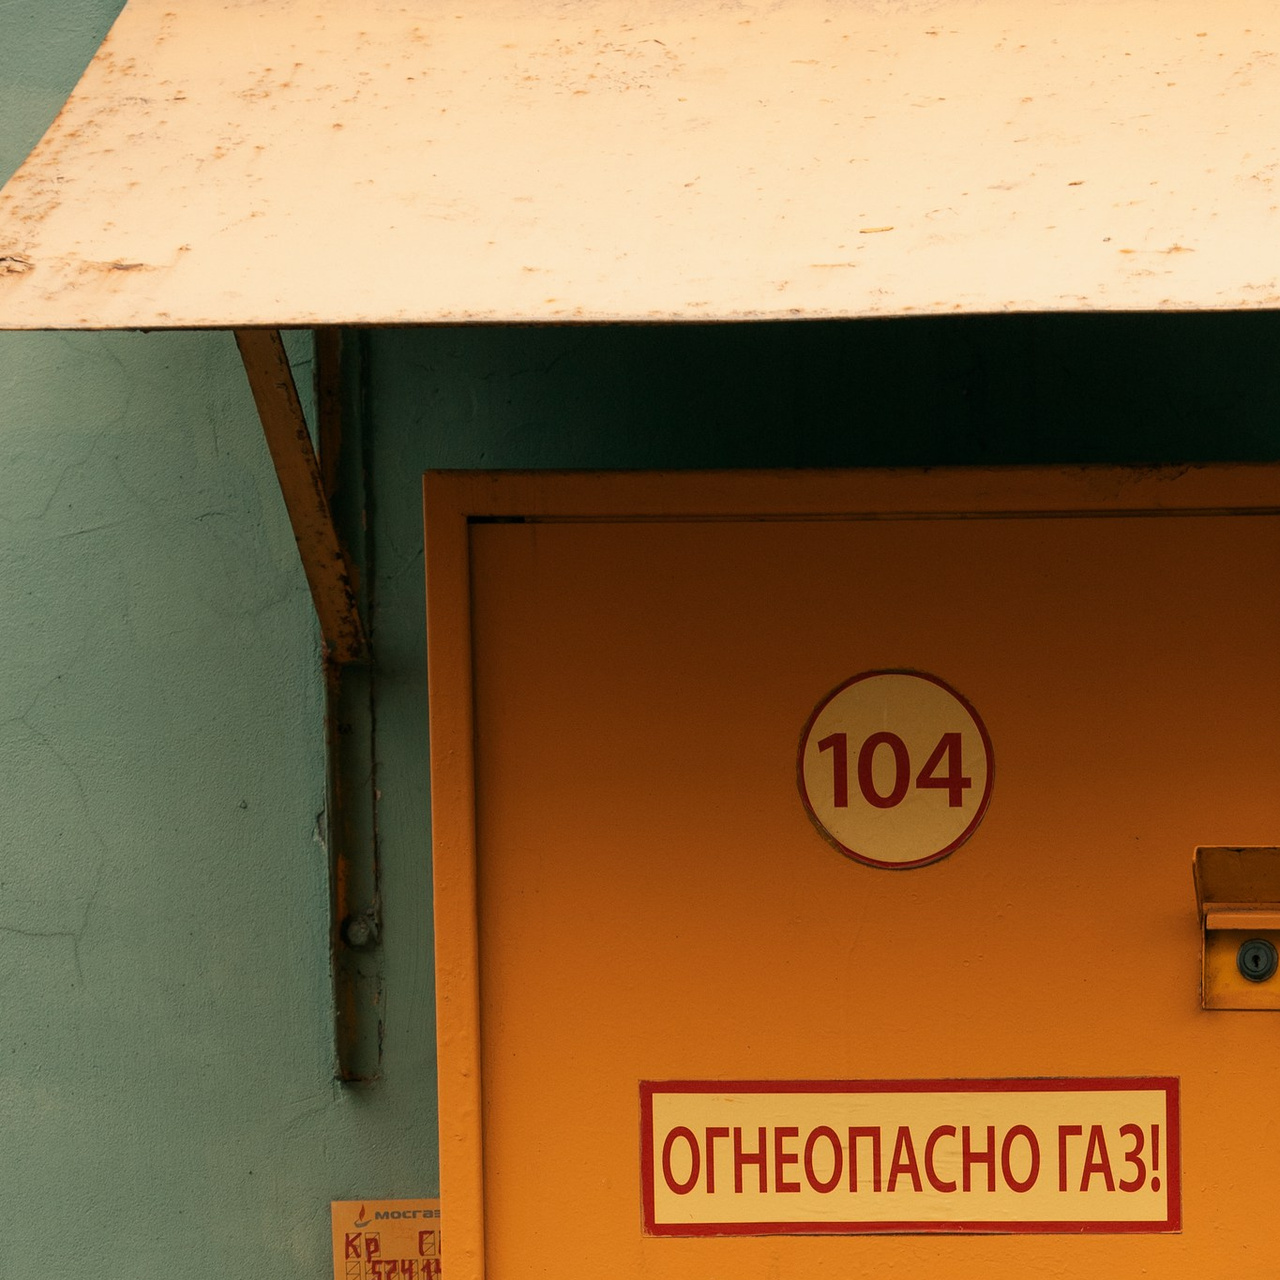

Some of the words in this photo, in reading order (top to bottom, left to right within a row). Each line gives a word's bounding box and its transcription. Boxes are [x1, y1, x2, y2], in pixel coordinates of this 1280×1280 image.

[816, 731, 972, 809] 104
[661, 1124, 1041, 1195] ОГНЕОПАСНО
[1057, 1122, 1161, 1192] ГАЗ!
